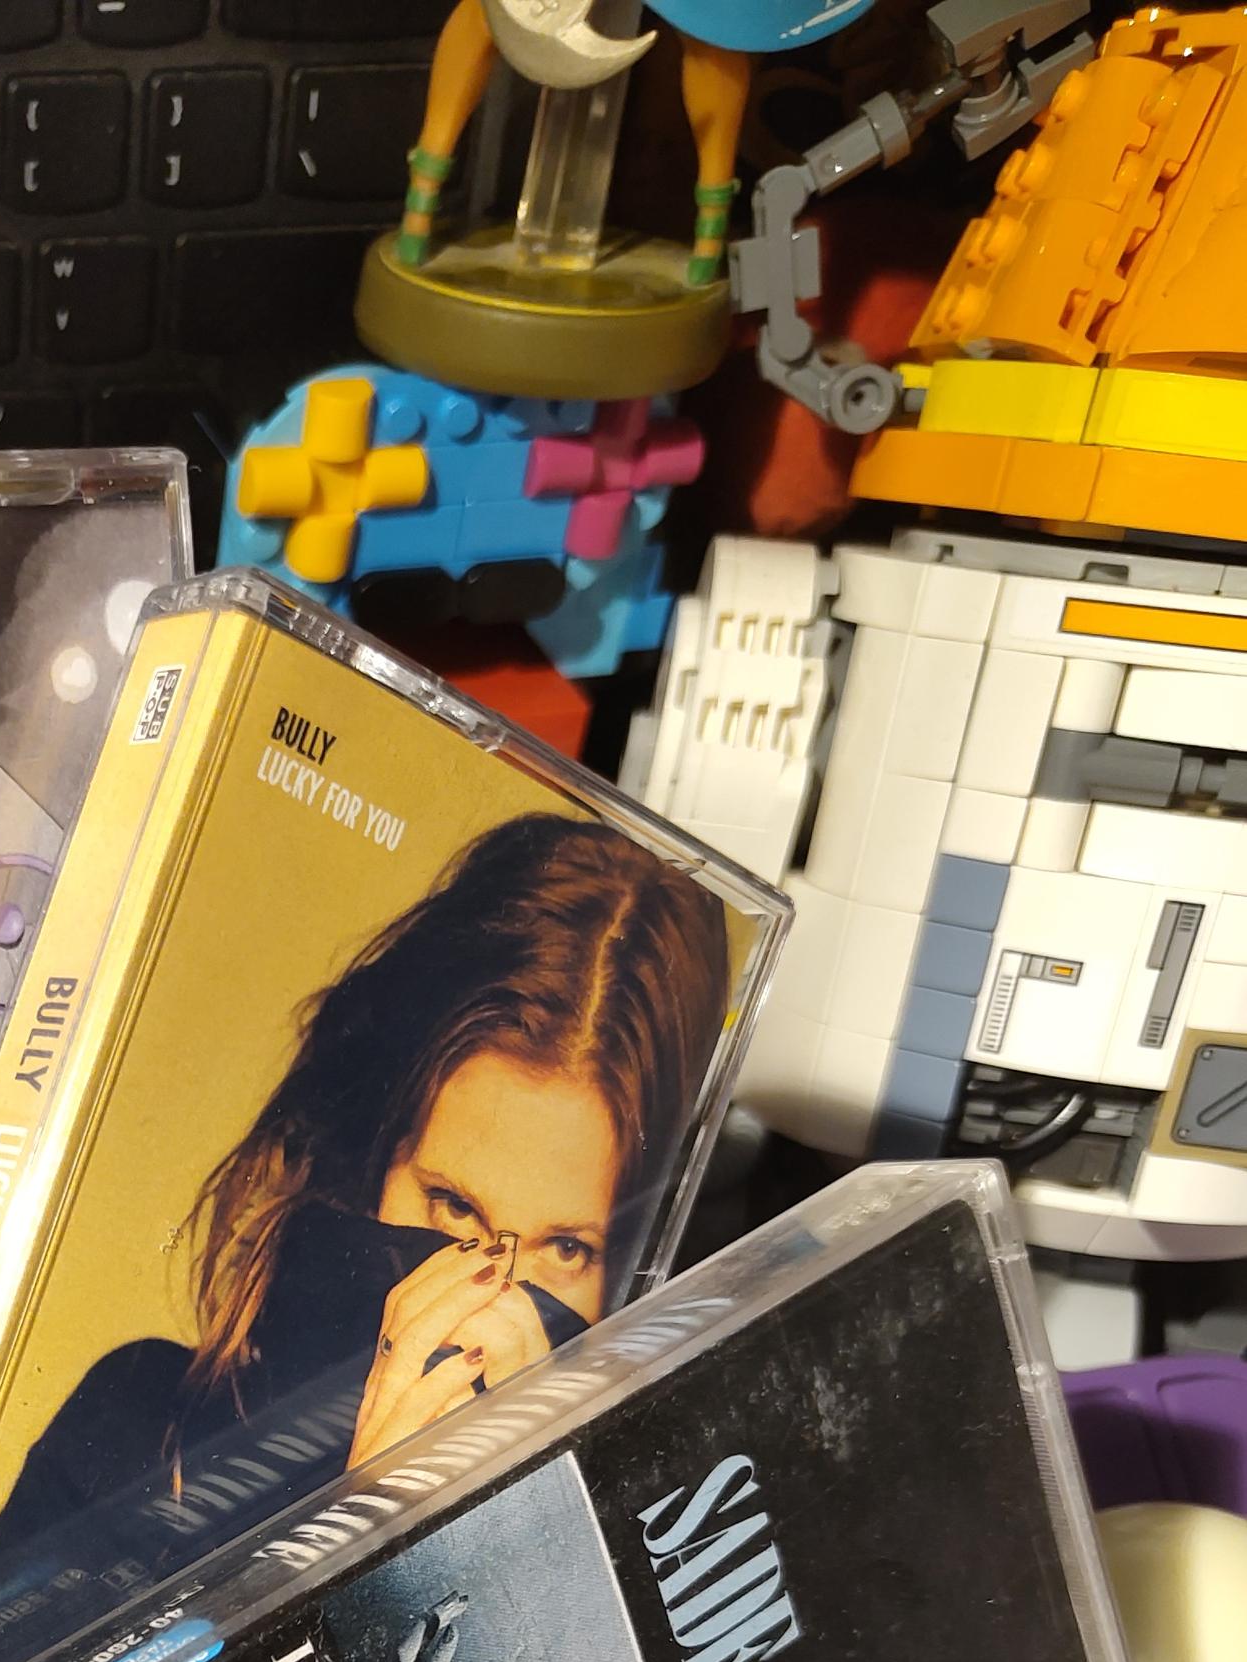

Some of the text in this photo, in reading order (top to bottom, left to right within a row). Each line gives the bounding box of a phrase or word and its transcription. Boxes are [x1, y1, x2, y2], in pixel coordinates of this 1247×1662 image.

[271, 705, 337, 766] BULLY
[256, 745, 407, 852] LUCKY FOR YOU
[15, 976, 79, 1092] BULLY
